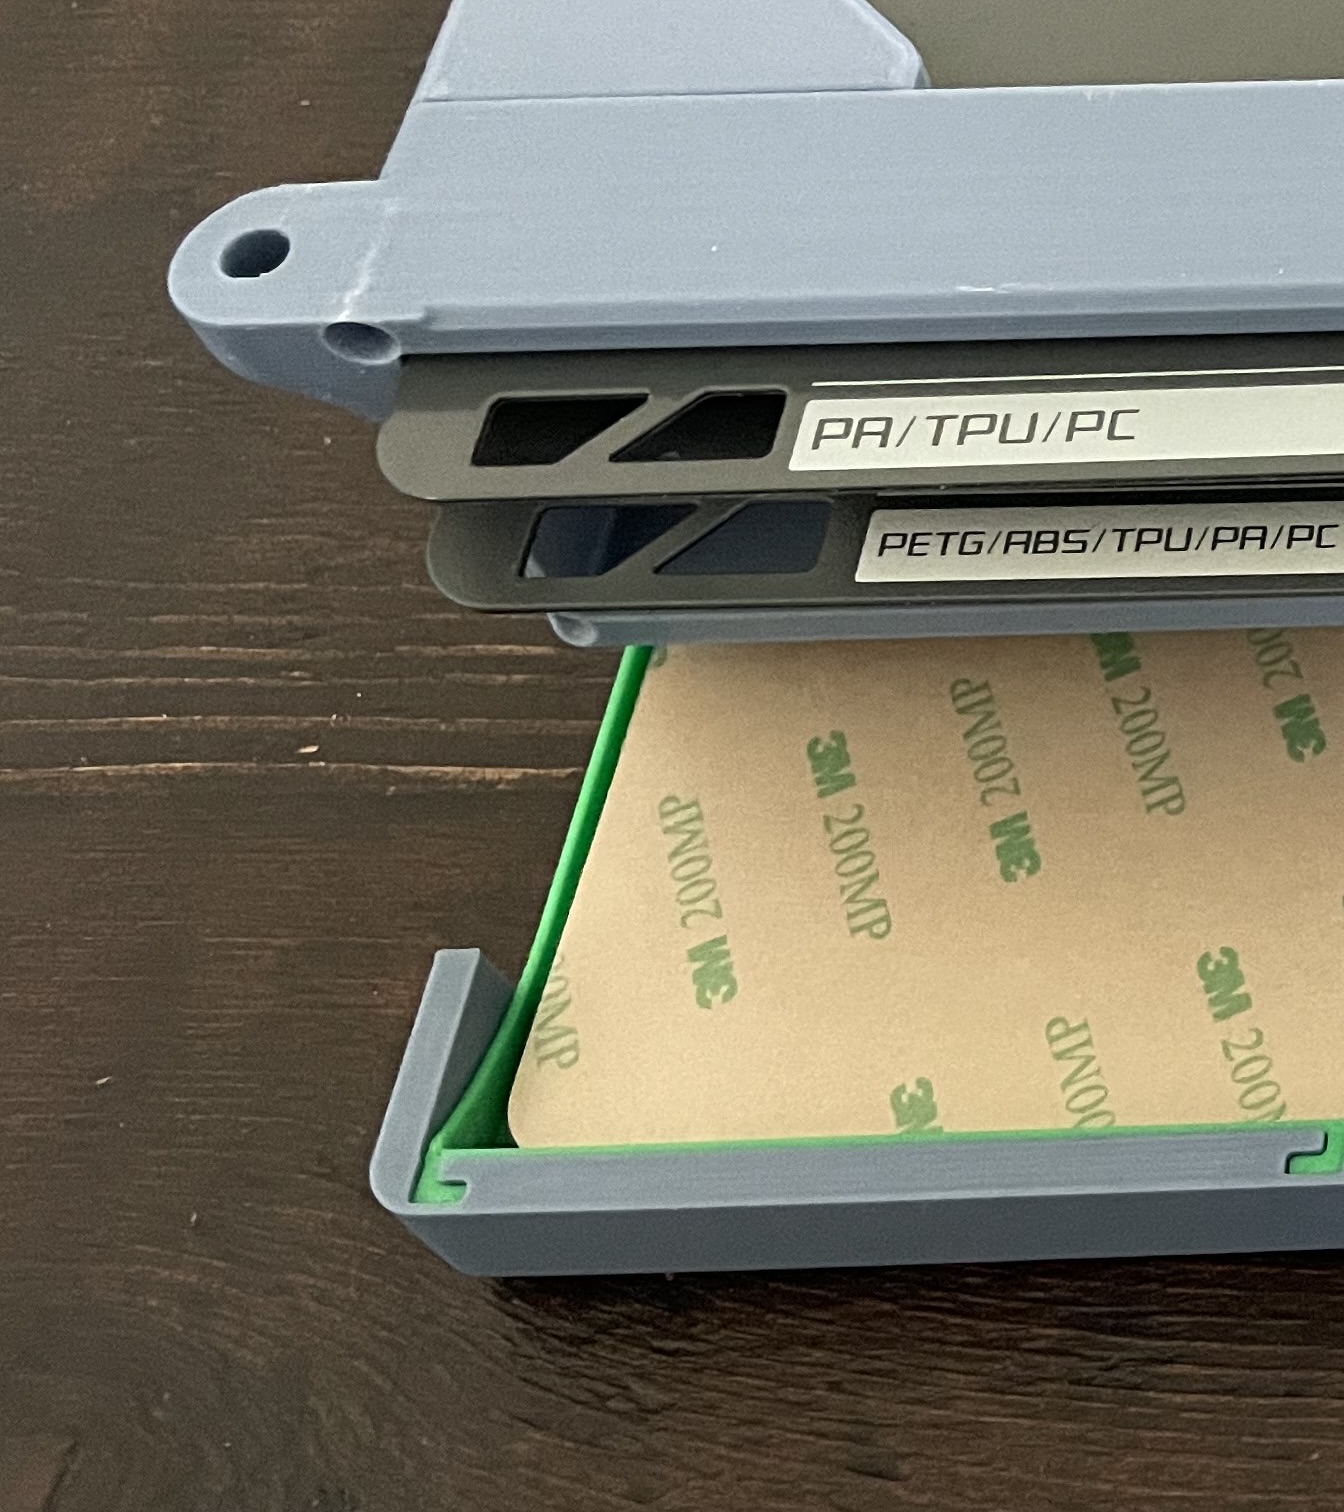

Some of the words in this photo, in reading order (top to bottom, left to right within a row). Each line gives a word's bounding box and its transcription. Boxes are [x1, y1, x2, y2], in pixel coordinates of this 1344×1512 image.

[811, 409, 1140, 450] PA/TPU/PC
[878, 523, 1340, 558] PETG/ABS/TPU/PA/PC
[1247, 628, 1306, 688] 200
[806, 730, 857, 798] 3M
[950, 677, 1022, 806] 200MP
[1111, 686, 1187, 817] 200MP
[1273, 693, 1327, 763] 3M
[657, 795, 723, 929] 200MP
[822, 803, 892, 940] 200MP
[988, 811, 1042, 883] 3M
[686, 934, 738, 1010] 3M
[1197, 946, 1252, 1023] 3M
[535, 955, 580, 1070] 0MP
[1045, 1016, 1116, 1129] 00MP
